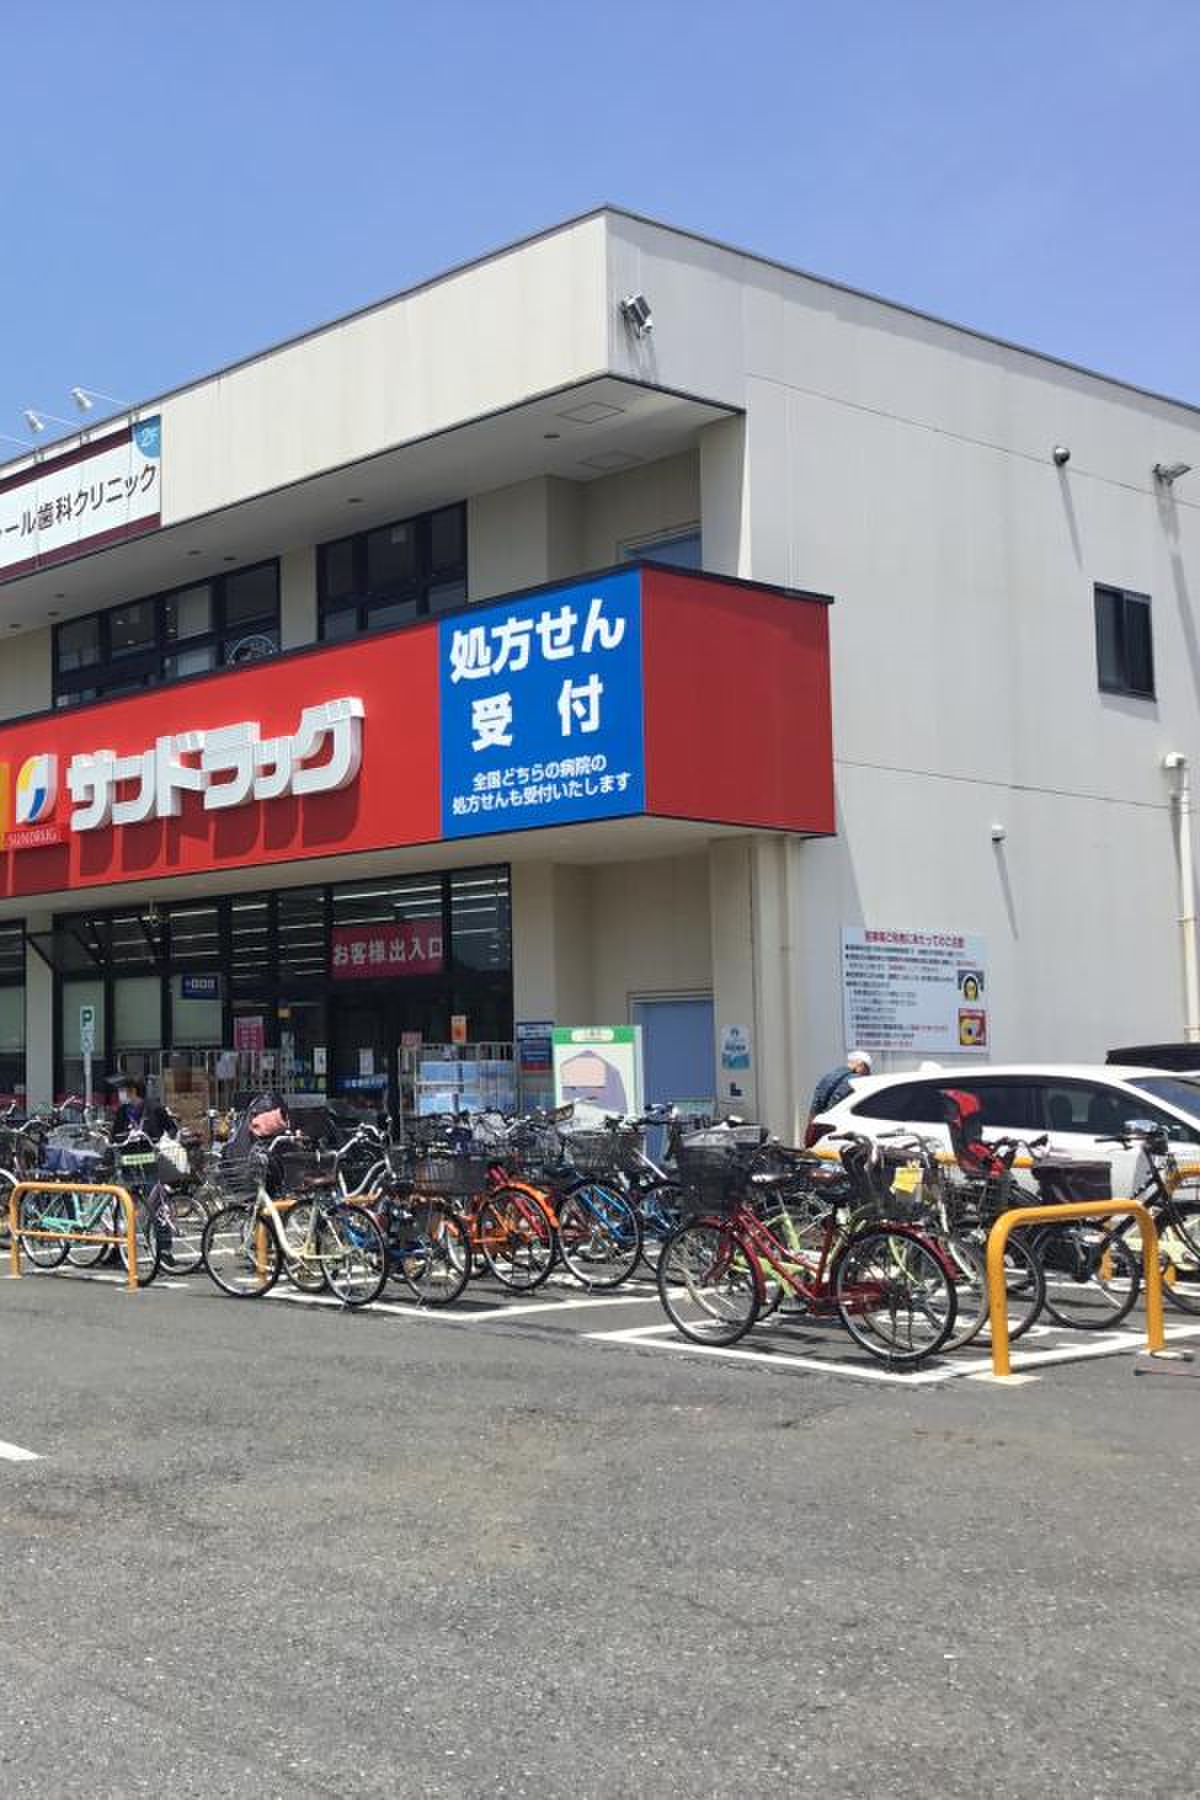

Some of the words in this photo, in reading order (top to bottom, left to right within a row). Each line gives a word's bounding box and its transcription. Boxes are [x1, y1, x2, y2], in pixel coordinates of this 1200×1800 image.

[450, 598, 625, 684] 処方せん
[66, 697, 366, 832] サンドラッグ
[473, 754, 607, 792] 全国どちらの病院の
[452, 771, 631, 815] 処方せんも受付いたします
[333, 937, 443, 966] お客様出入口
[82, 1009, 92, 1027] P
